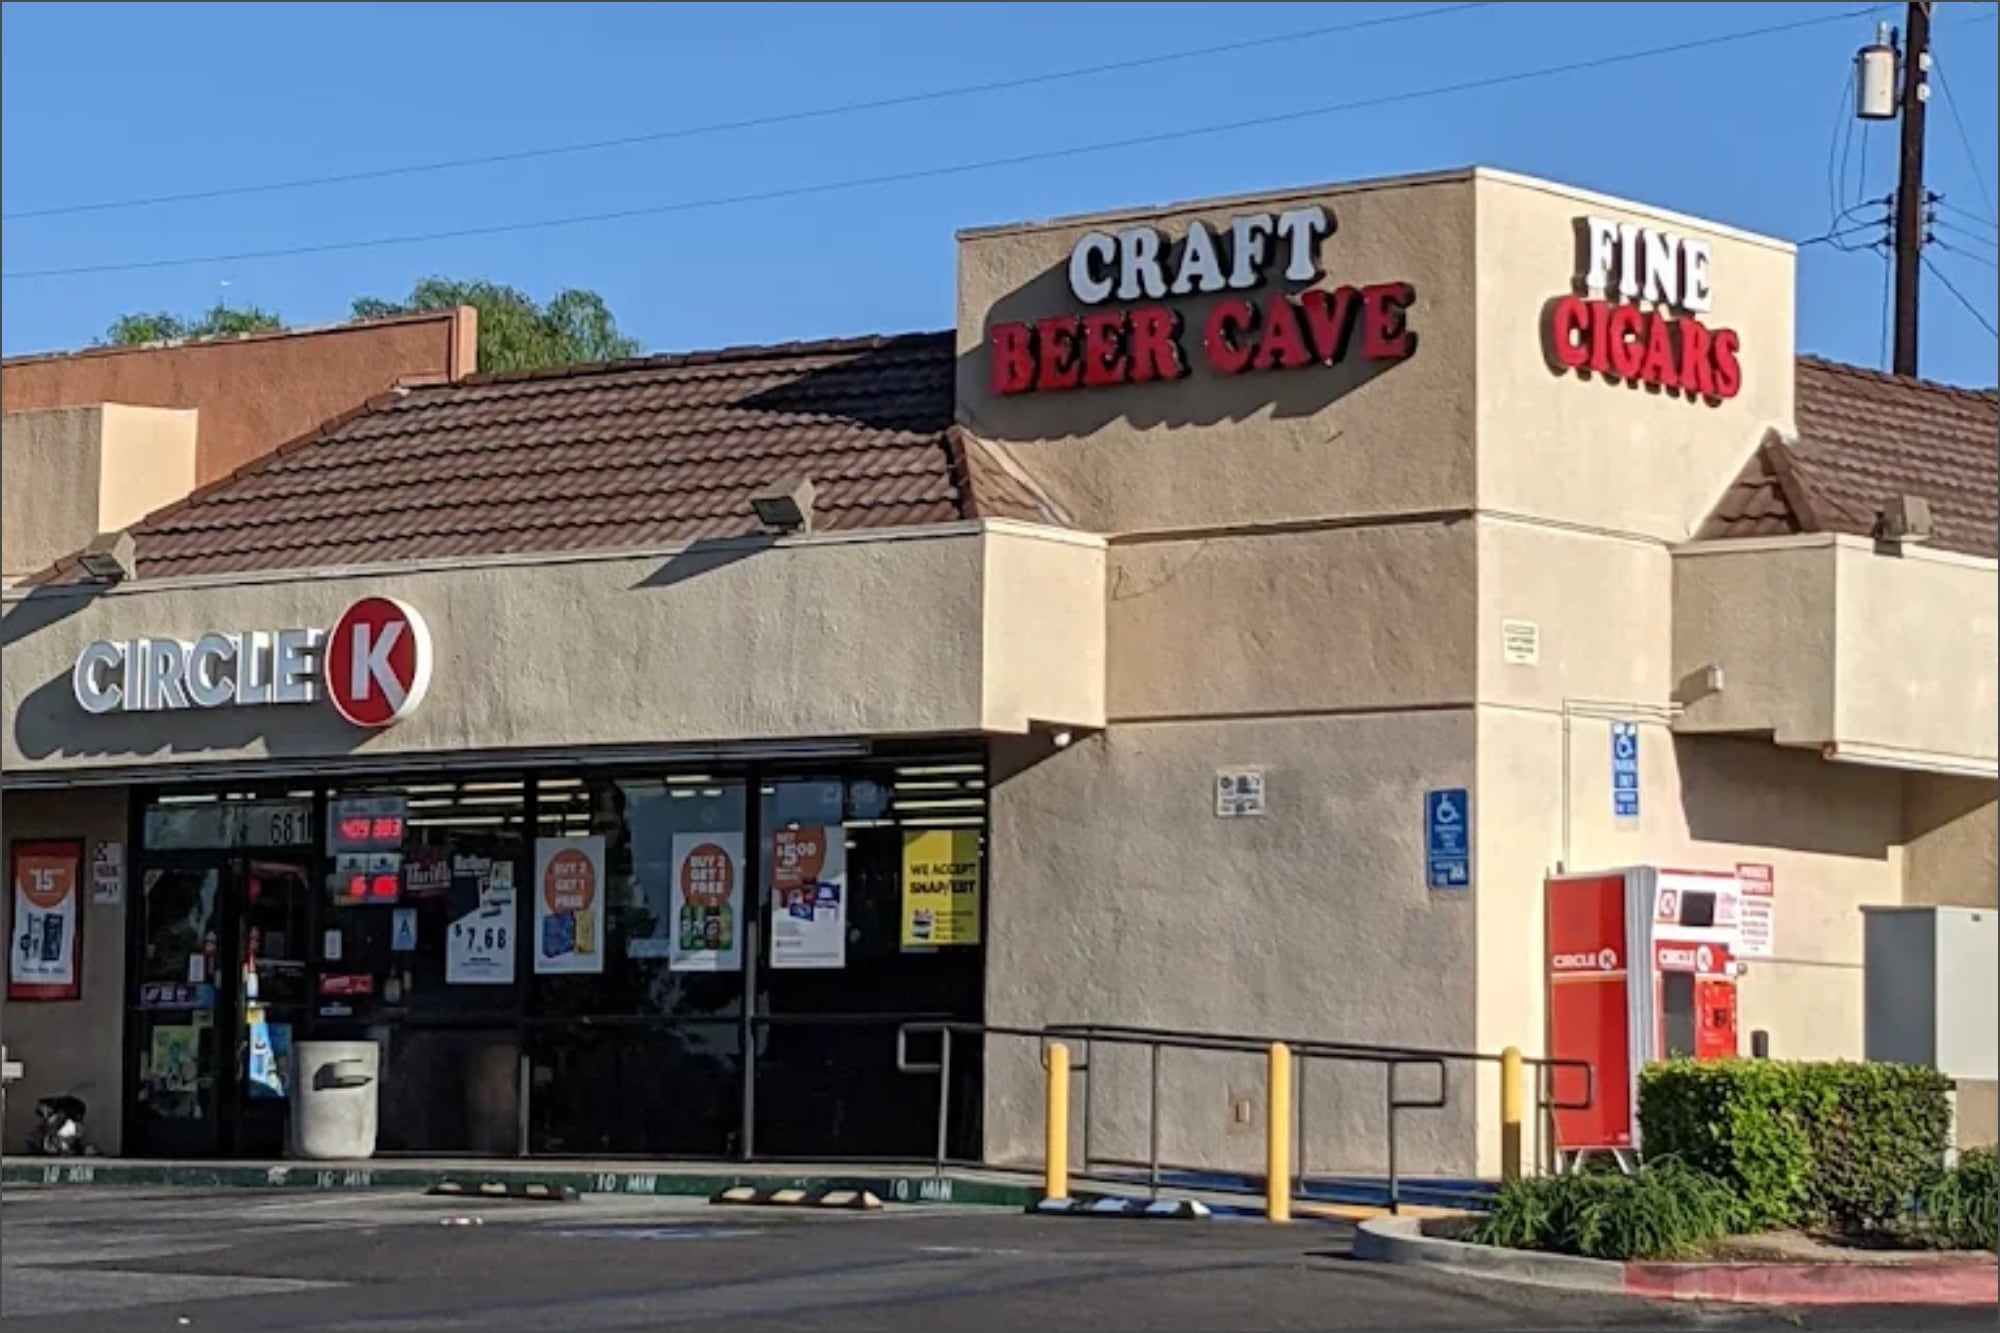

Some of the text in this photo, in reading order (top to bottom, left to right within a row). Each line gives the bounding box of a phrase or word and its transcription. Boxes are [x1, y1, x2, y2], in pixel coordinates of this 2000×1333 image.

[1068, 205, 1338, 305] CRAFT
[1585, 215, 1712, 313] FINE
[990, 282, 1416, 395] BEER CAVE
[1550, 294, 1741, 399] CIGARS
[73, 629, 322, 713] CIRCLE
[690, 856, 716, 867] BUY
[910, 863, 976, 875] WE ACCEPT
[690, 868, 716, 880] GET
[690, 881, 725, 894] FREE
[401, 918, 411, 934] A
[317, 1170, 334, 1187] 10
[597, 1174, 616, 1191] 10
[888, 1179, 952, 1200] 10 MIN
